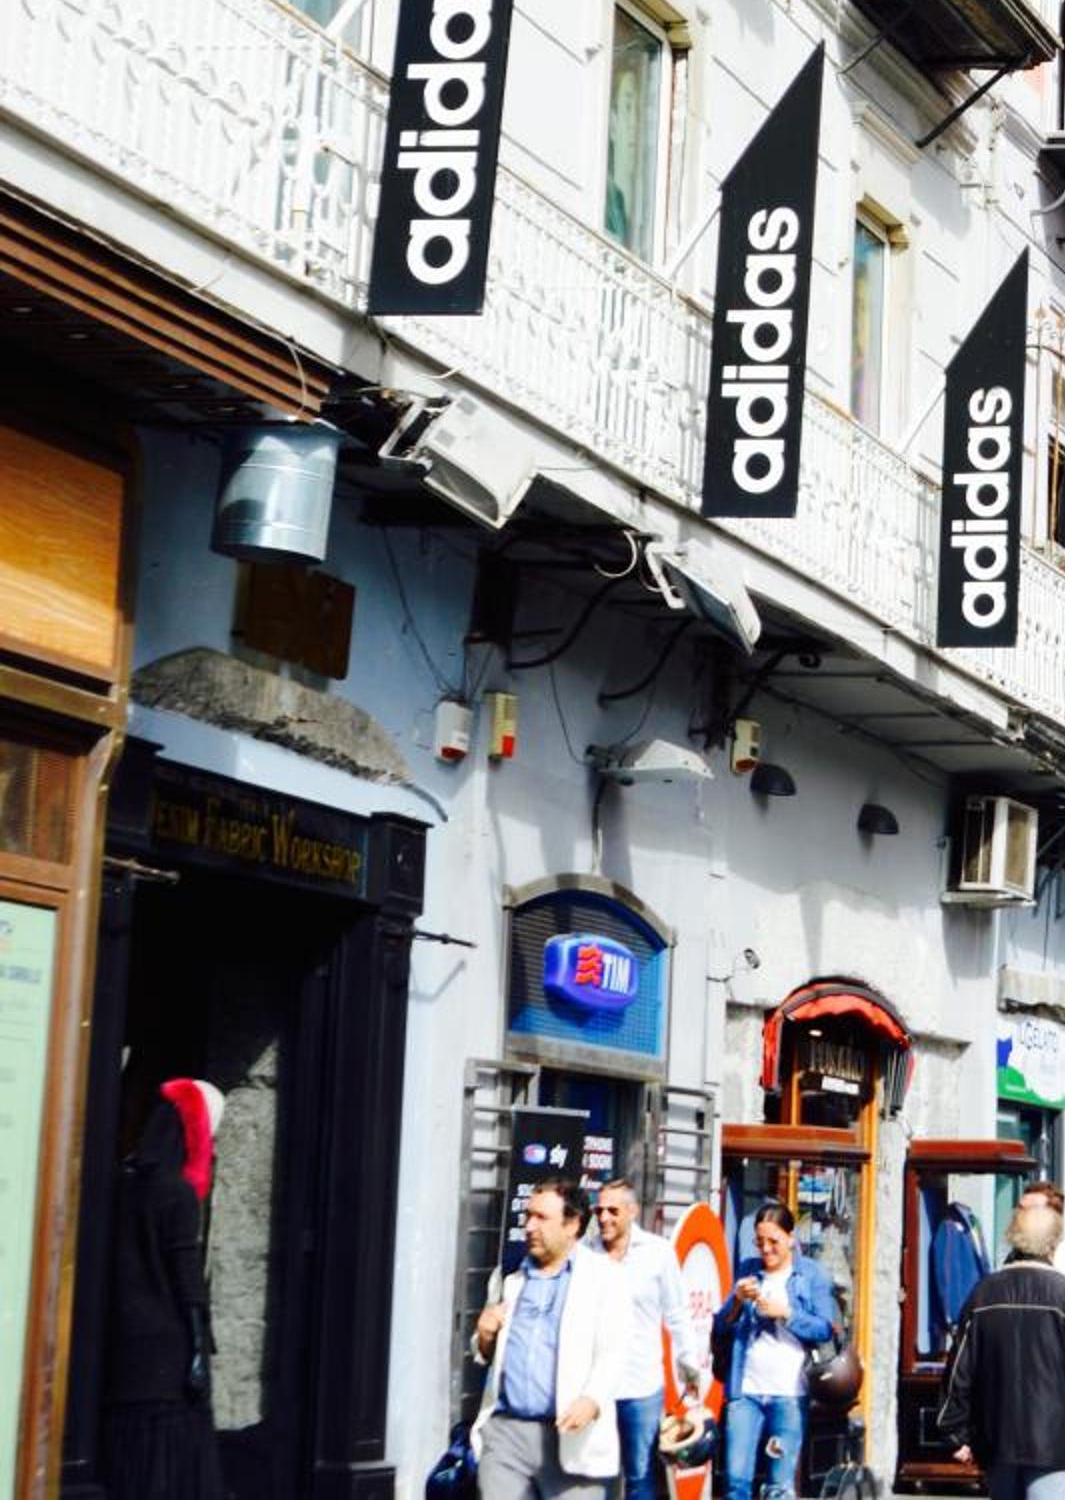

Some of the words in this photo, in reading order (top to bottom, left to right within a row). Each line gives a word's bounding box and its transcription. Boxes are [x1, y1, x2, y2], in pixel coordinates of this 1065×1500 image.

[721, 207, 800, 494] adidas
[950, 386, 1013, 629] adidas
[271, 809, 362, 884] WORKSHOP
[602, 953, 630, 994] TIM
